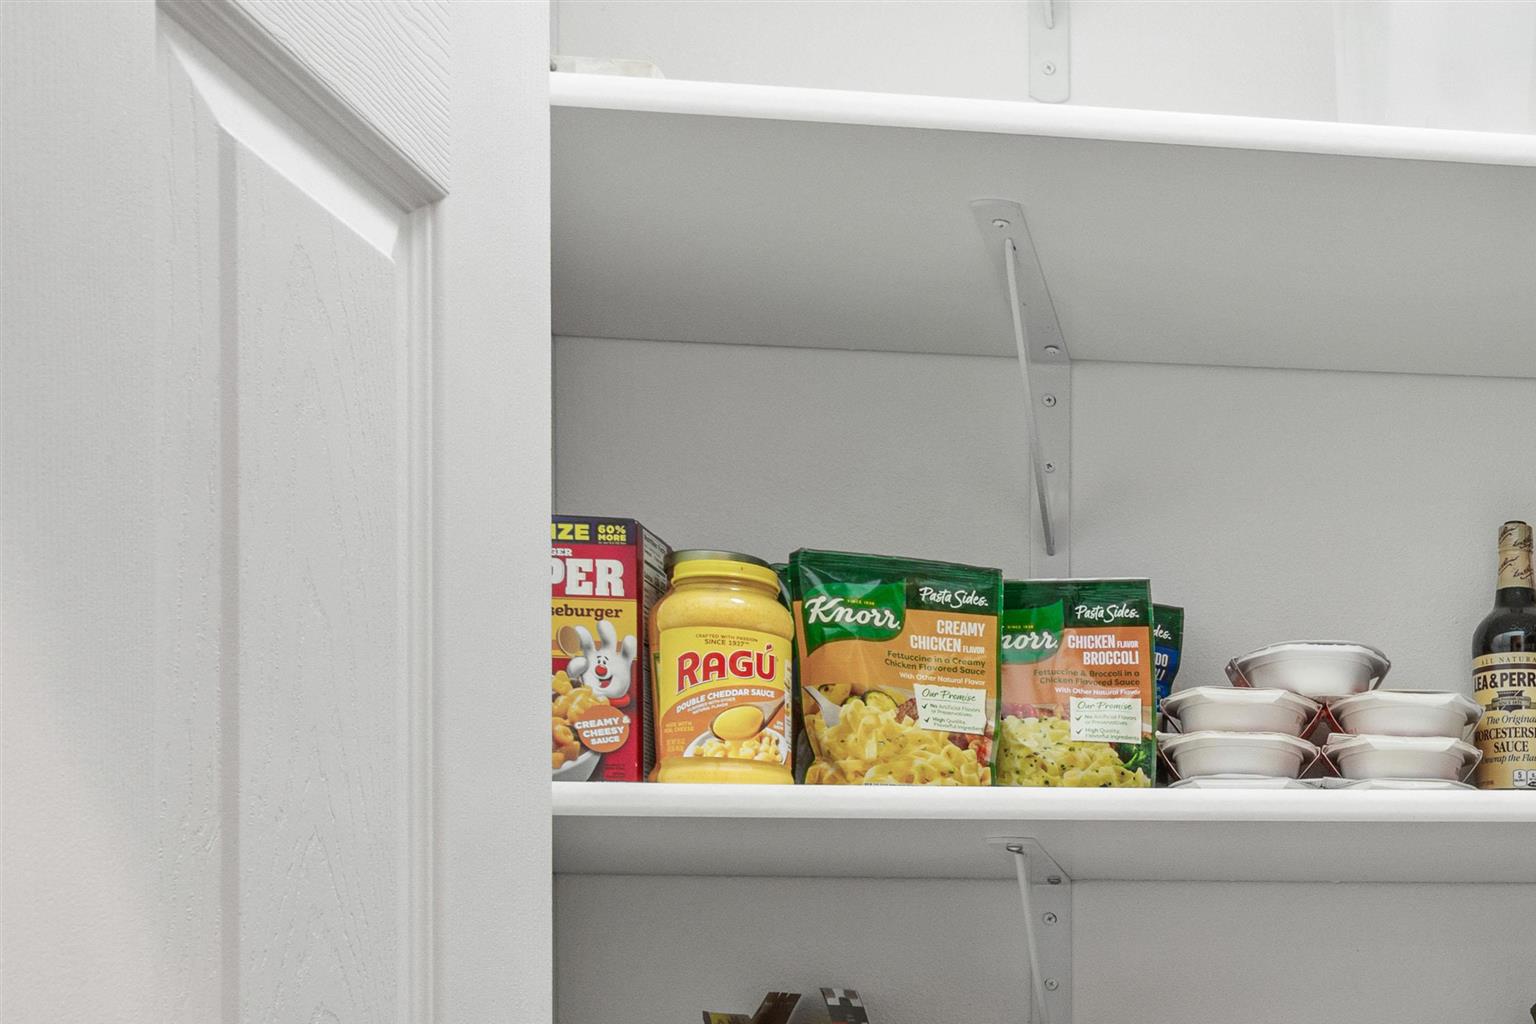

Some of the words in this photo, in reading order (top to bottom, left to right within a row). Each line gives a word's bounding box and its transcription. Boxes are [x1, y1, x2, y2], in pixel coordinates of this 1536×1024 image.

[597, 525, 626, 534] 60%
[597, 533, 627, 542] MORE
[919, 586, 953, 603] Pasta
[804, 595, 901, 630] Knorr
[1074, 605, 1105, 620] Pasta
[936, 619, 986, 637] CREAMY
[909, 634, 962, 653] CHICKEN
[1067, 634, 1116, 649] CHICKEN
[1117, 640, 1139, 648] FLAVOR
[887, 650, 932, 662] Fettuccine
[951, 656, 986, 668] Creamy
[1083, 651, 1139, 665] BROCCOLI
[884, 658, 917, 671] Chicken
[918, 661, 958, 673] Flavored
[959, 665, 986, 676] Sauce
[1033, 669, 1079, 677] Fettuccine
[1089, 669, 1123, 678] Broccoli
[1040, 676, 1074, 685] Chicken
[1074, 677, 1112, 687] Flavored
[1113, 678, 1140, 686] Sauce
[1474, 675, 1490, 691] LEA
[676, 695, 706, 713] DOUBLE
[707, 689, 750, 703] CHEDDAR
[751, 689, 776, 698] SAUCE
[574, 716, 620, 730] CREAMY
[1486, 715, 1501, 725] The
[582, 726, 625, 738] CHEESY
[590, 735, 620, 745] SAUCE
[1493, 740, 1529, 753] SAUCE
